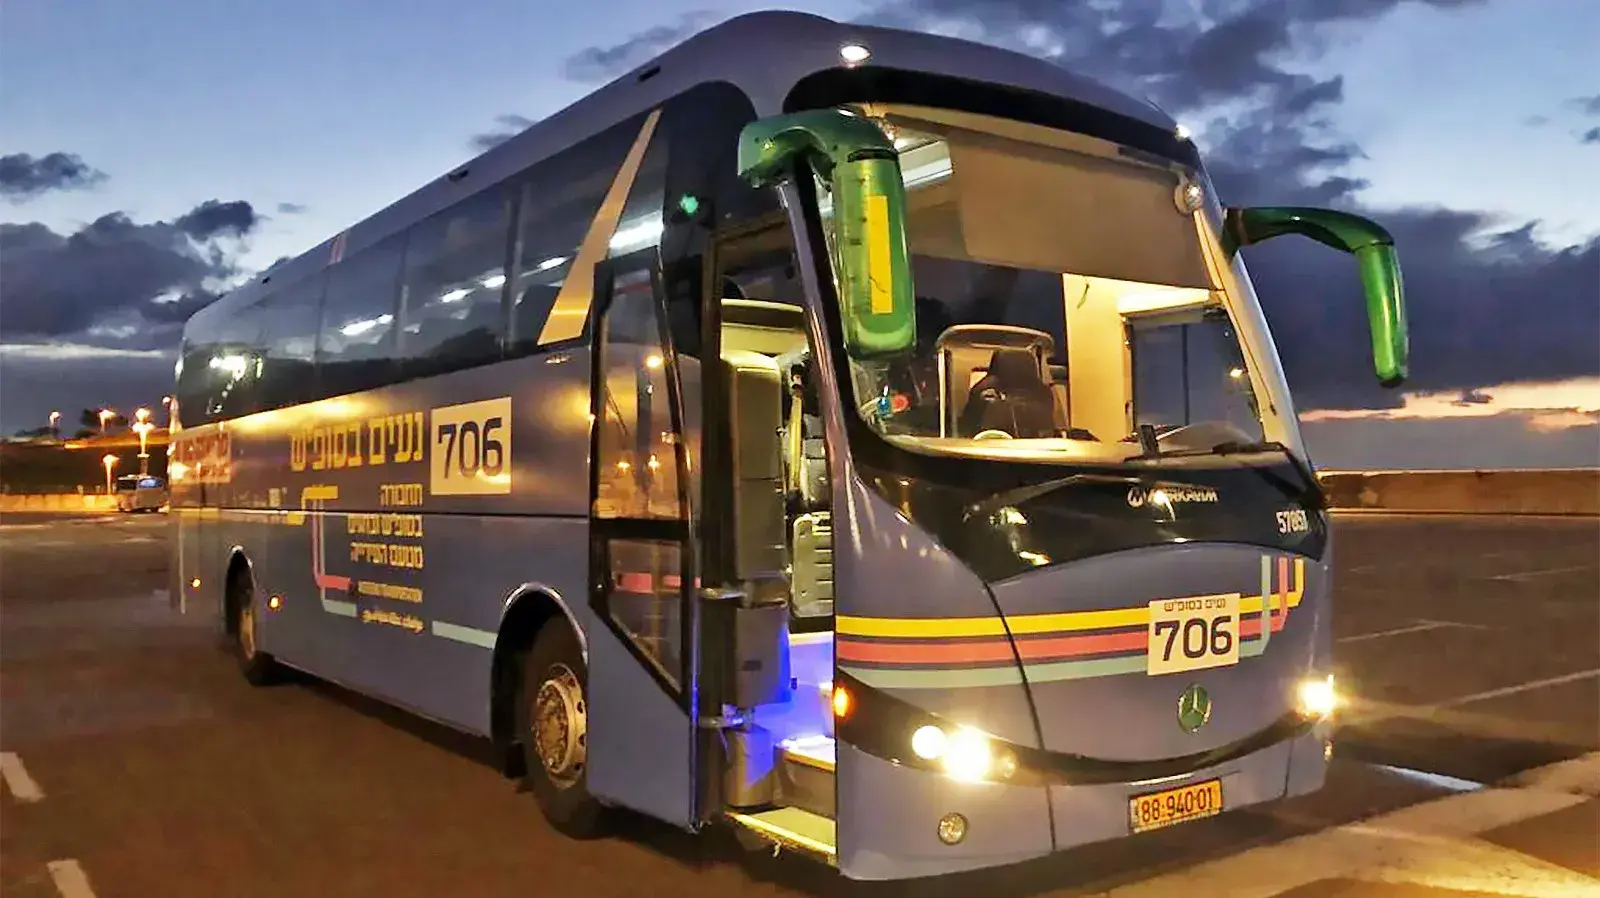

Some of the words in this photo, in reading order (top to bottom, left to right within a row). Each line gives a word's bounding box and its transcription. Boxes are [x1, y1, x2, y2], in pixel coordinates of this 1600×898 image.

[368, 411, 423, 464] נעים
[438, 417, 503, 479] 706
[1154, 615, 1233, 662] 706
